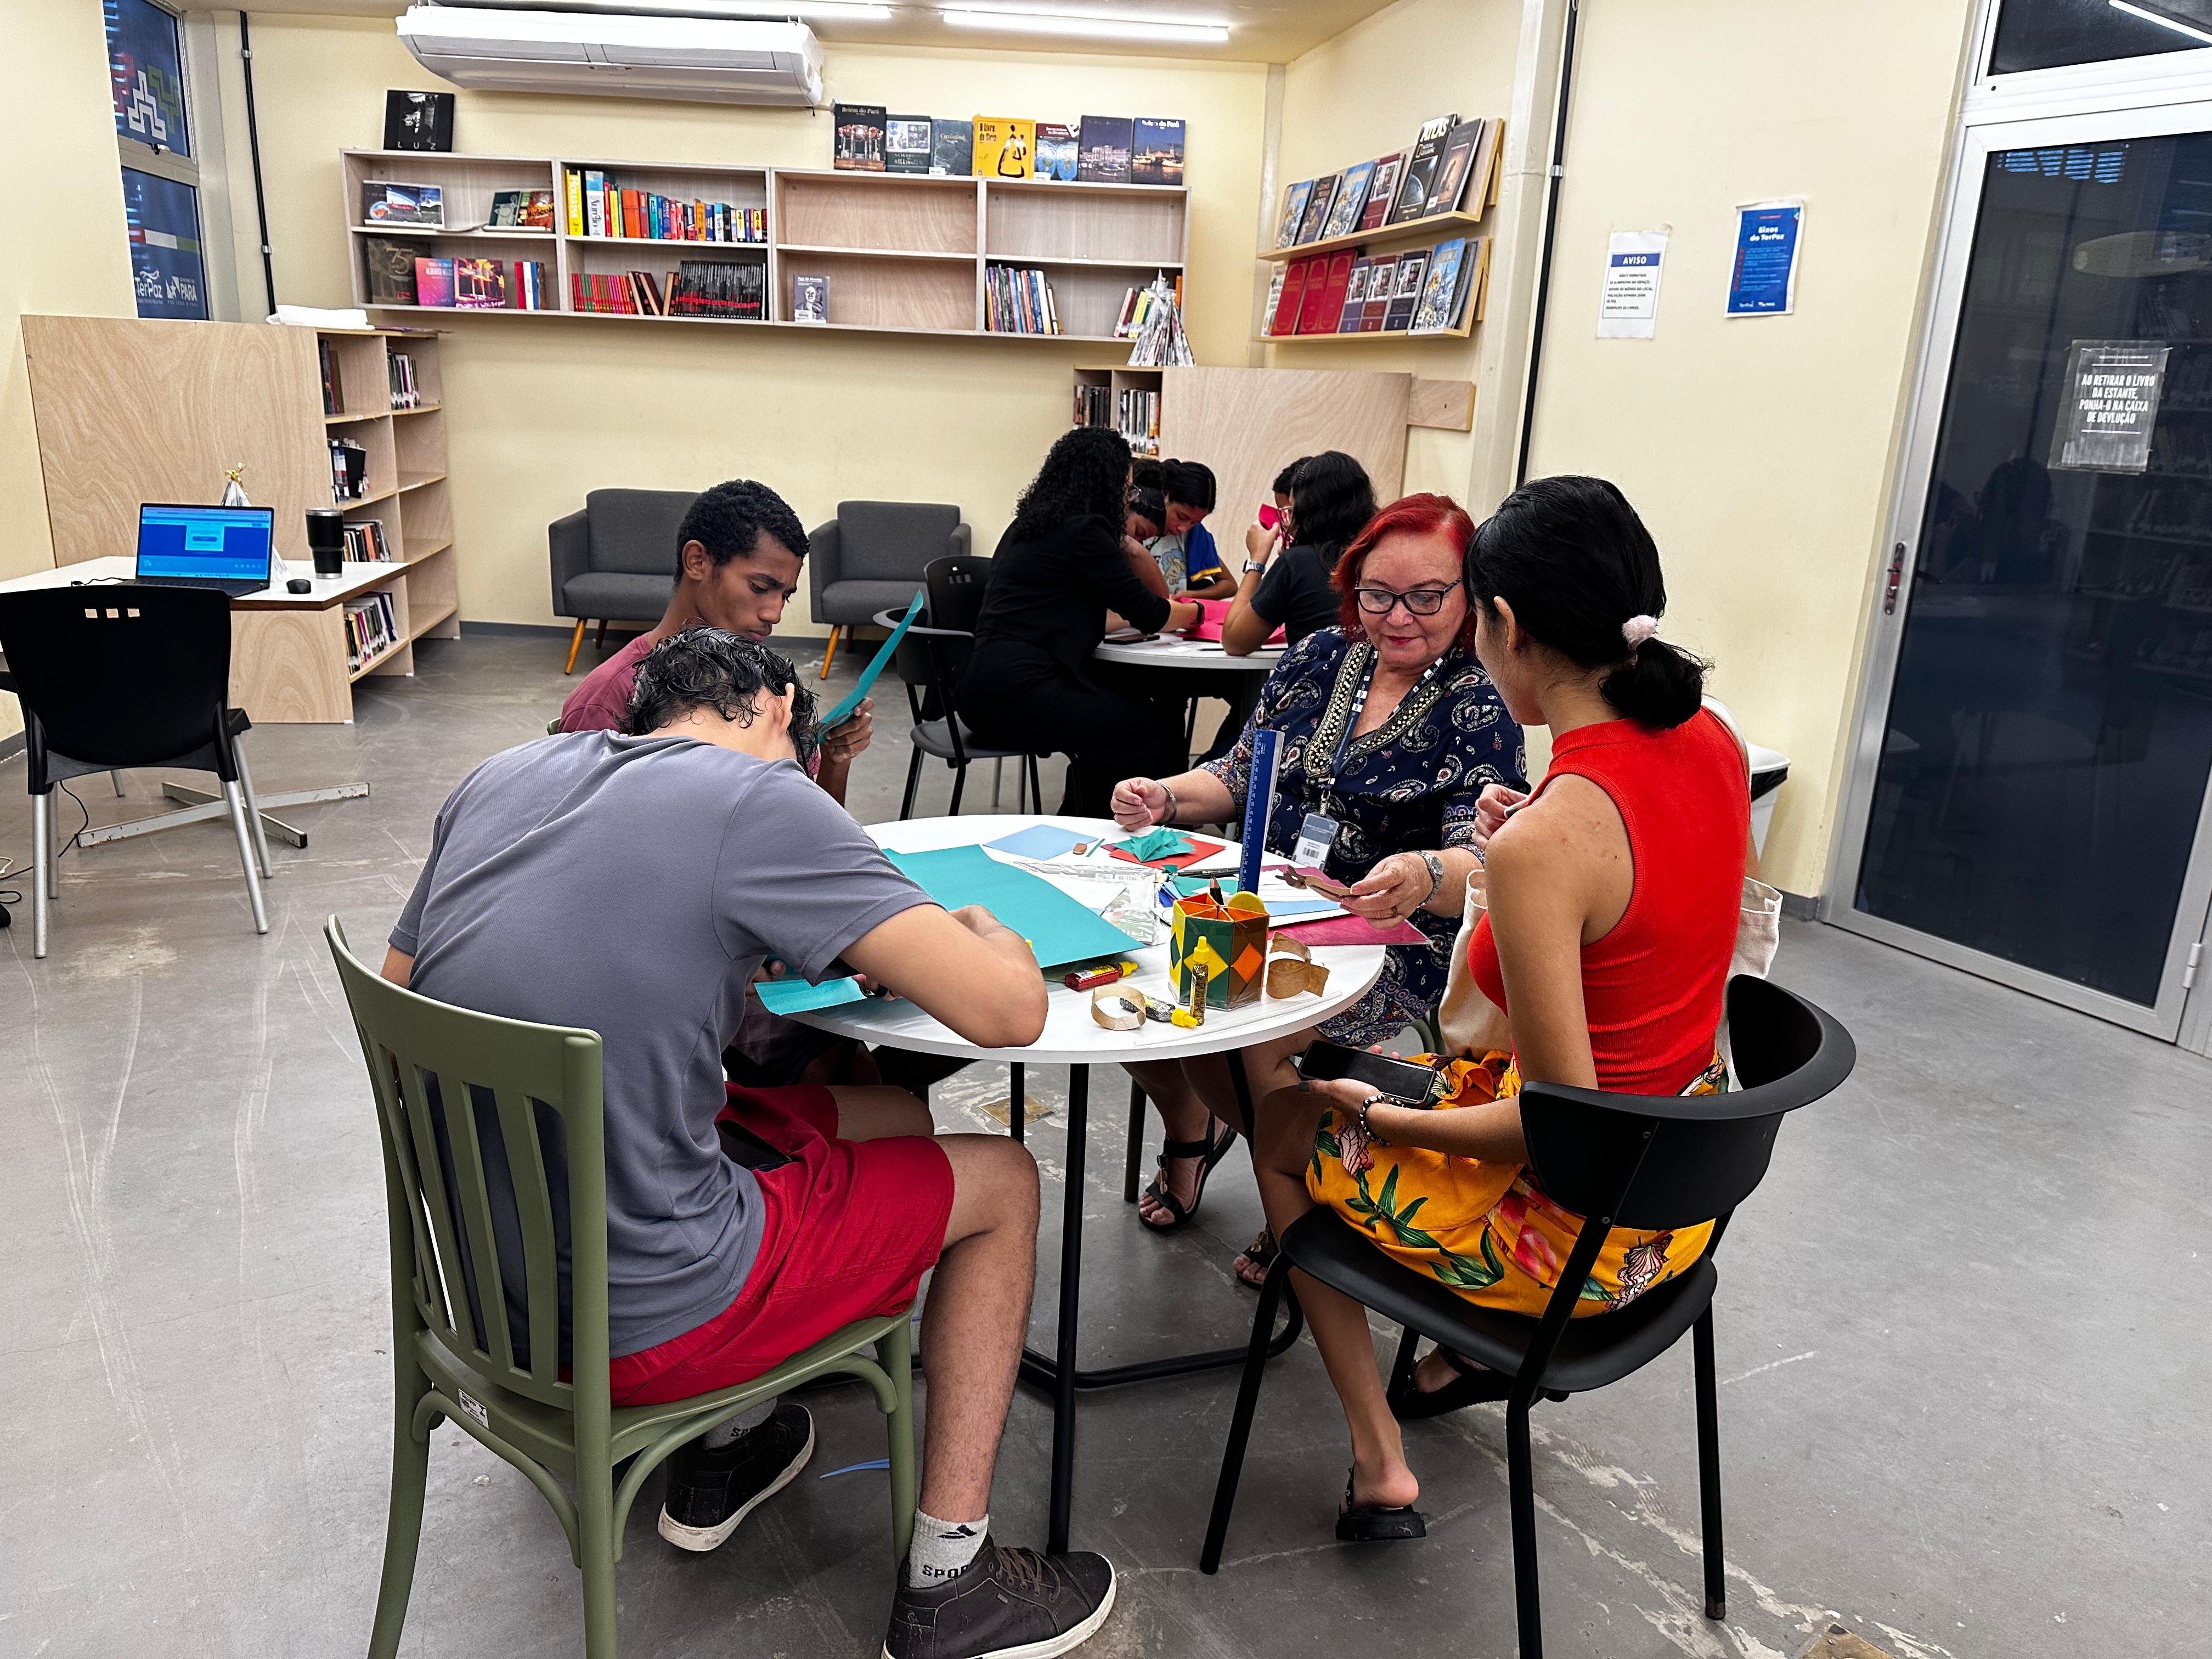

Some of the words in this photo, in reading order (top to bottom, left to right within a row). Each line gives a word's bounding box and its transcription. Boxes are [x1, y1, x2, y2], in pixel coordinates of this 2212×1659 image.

[1420, 117, 1449, 143] ATLAS
[386, 247, 413, 274] 75
[1622, 256, 1647, 264] AVISO
[134, 276, 163, 299] TerPaz
[2081, 374, 2092, 386] AO
[2094, 375, 2125, 386] RETIRAR
[2125, 375, 2132, 386] O
[2132, 375, 2155, 387] LIVRO
[2092, 387, 2102, 398] DA
[2104, 387, 2138, 400] ESTANTE,
[2079, 399, 2112, 410] PONHA-O
[2113, 400, 2124, 410] NA
[2125, 401, 2148, 412] CAIXA
[2086, 412, 2096, 422] DE
